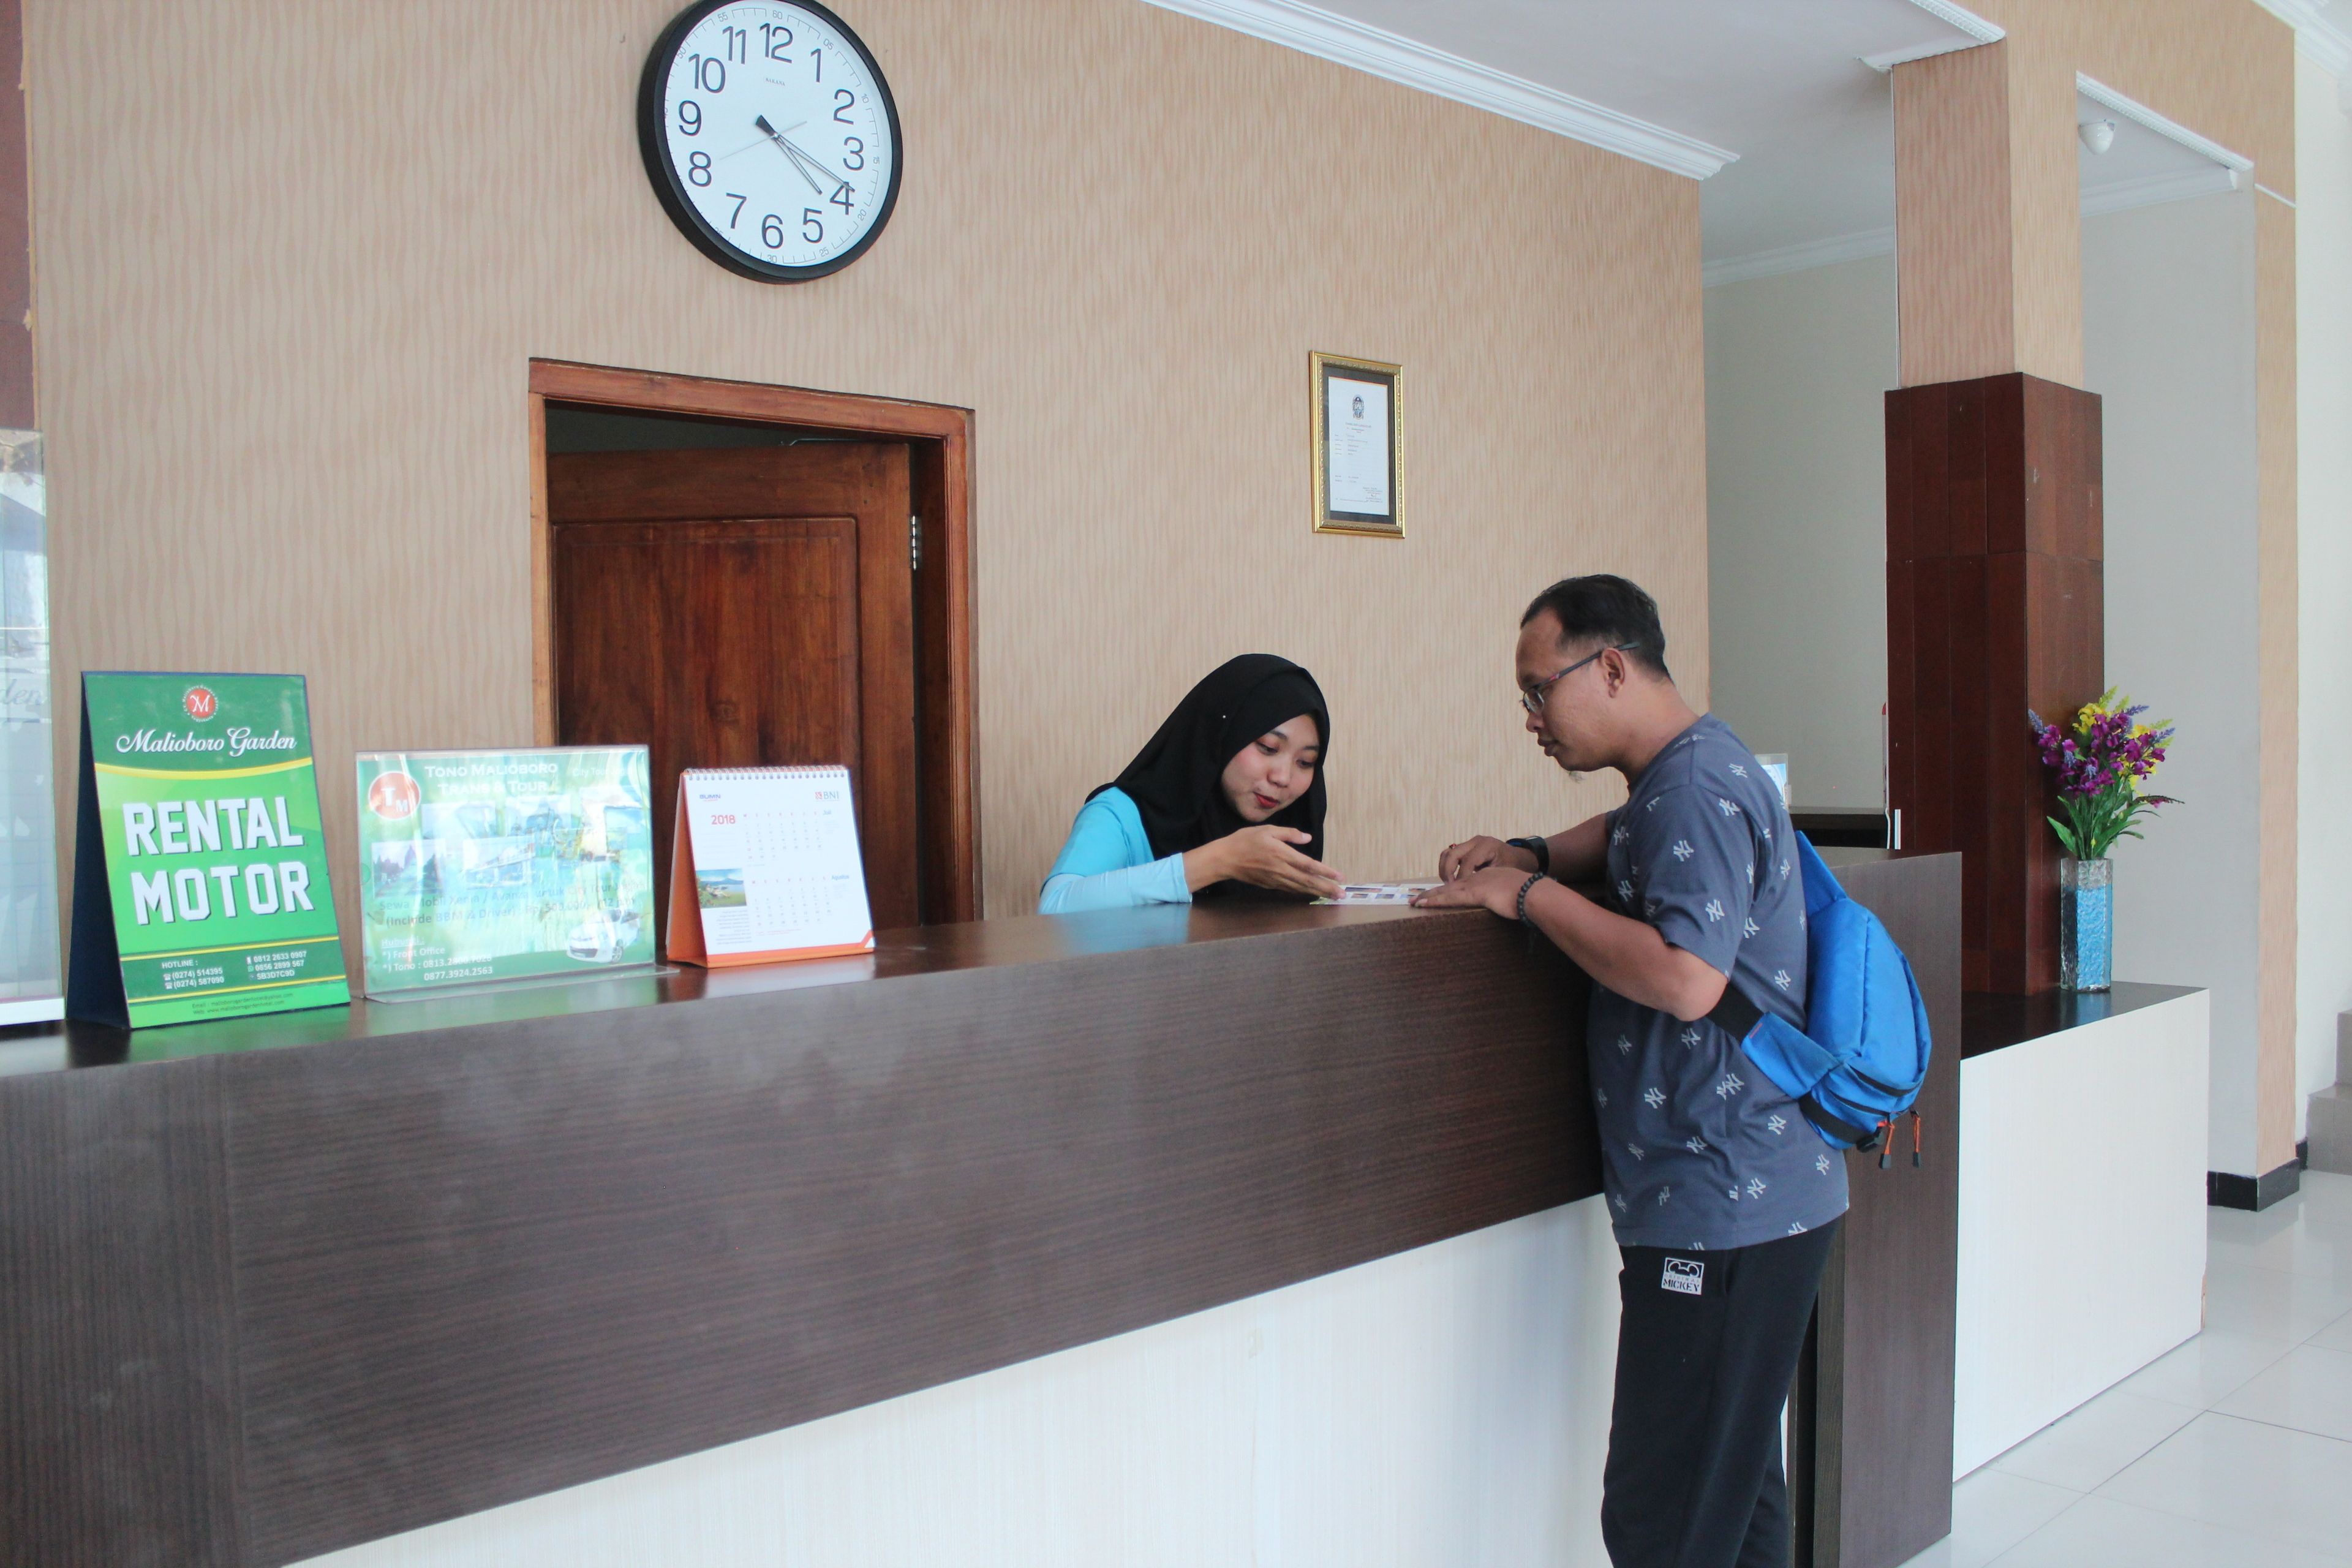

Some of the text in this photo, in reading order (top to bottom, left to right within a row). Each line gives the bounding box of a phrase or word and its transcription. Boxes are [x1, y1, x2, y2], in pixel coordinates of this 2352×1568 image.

[717, 12, 728, 22] 55
[772, 10, 783, 20] 60
[722, 26, 746, 65] 11
[760, 23, 793, 64] 12
[823, 39, 834, 50] 05
[688, 53, 726, 93] 10
[810, 48, 821, 83] 1
[679, 100, 702, 136] 9
[834, 89, 854, 125] 2
[843, 136, 864, 171] 3
[688, 151, 712, 187] 8
[829, 181, 854, 215] 4
[726, 192, 747, 229] 7
[858, 209, 867, 221] 20
[761, 214, 783, 249] 6
[802, 208, 823, 243] 5
[819, 247, 829, 258] 25
[190, 695, 209, 712] M
[116, 727, 297, 757] Malioboro Garden
[823, 791, 839, 800] BNI
[123, 796, 304, 856] RENTAL
[711, 815, 736, 825] 2018
[130, 861, 315, 926] MOTOR
[420, 947, 446, 956] Office
[162, 959, 194, 969] HOTLINE
[172, 967, 223, 981] (0274) 514395
[394, 962, 415, 971] Tono
[424, 966, 493, 981] 0877.3924.2563
[173, 976, 225, 990] (0274) 587090
[1663, 1278, 1700, 1292] MICKEY
